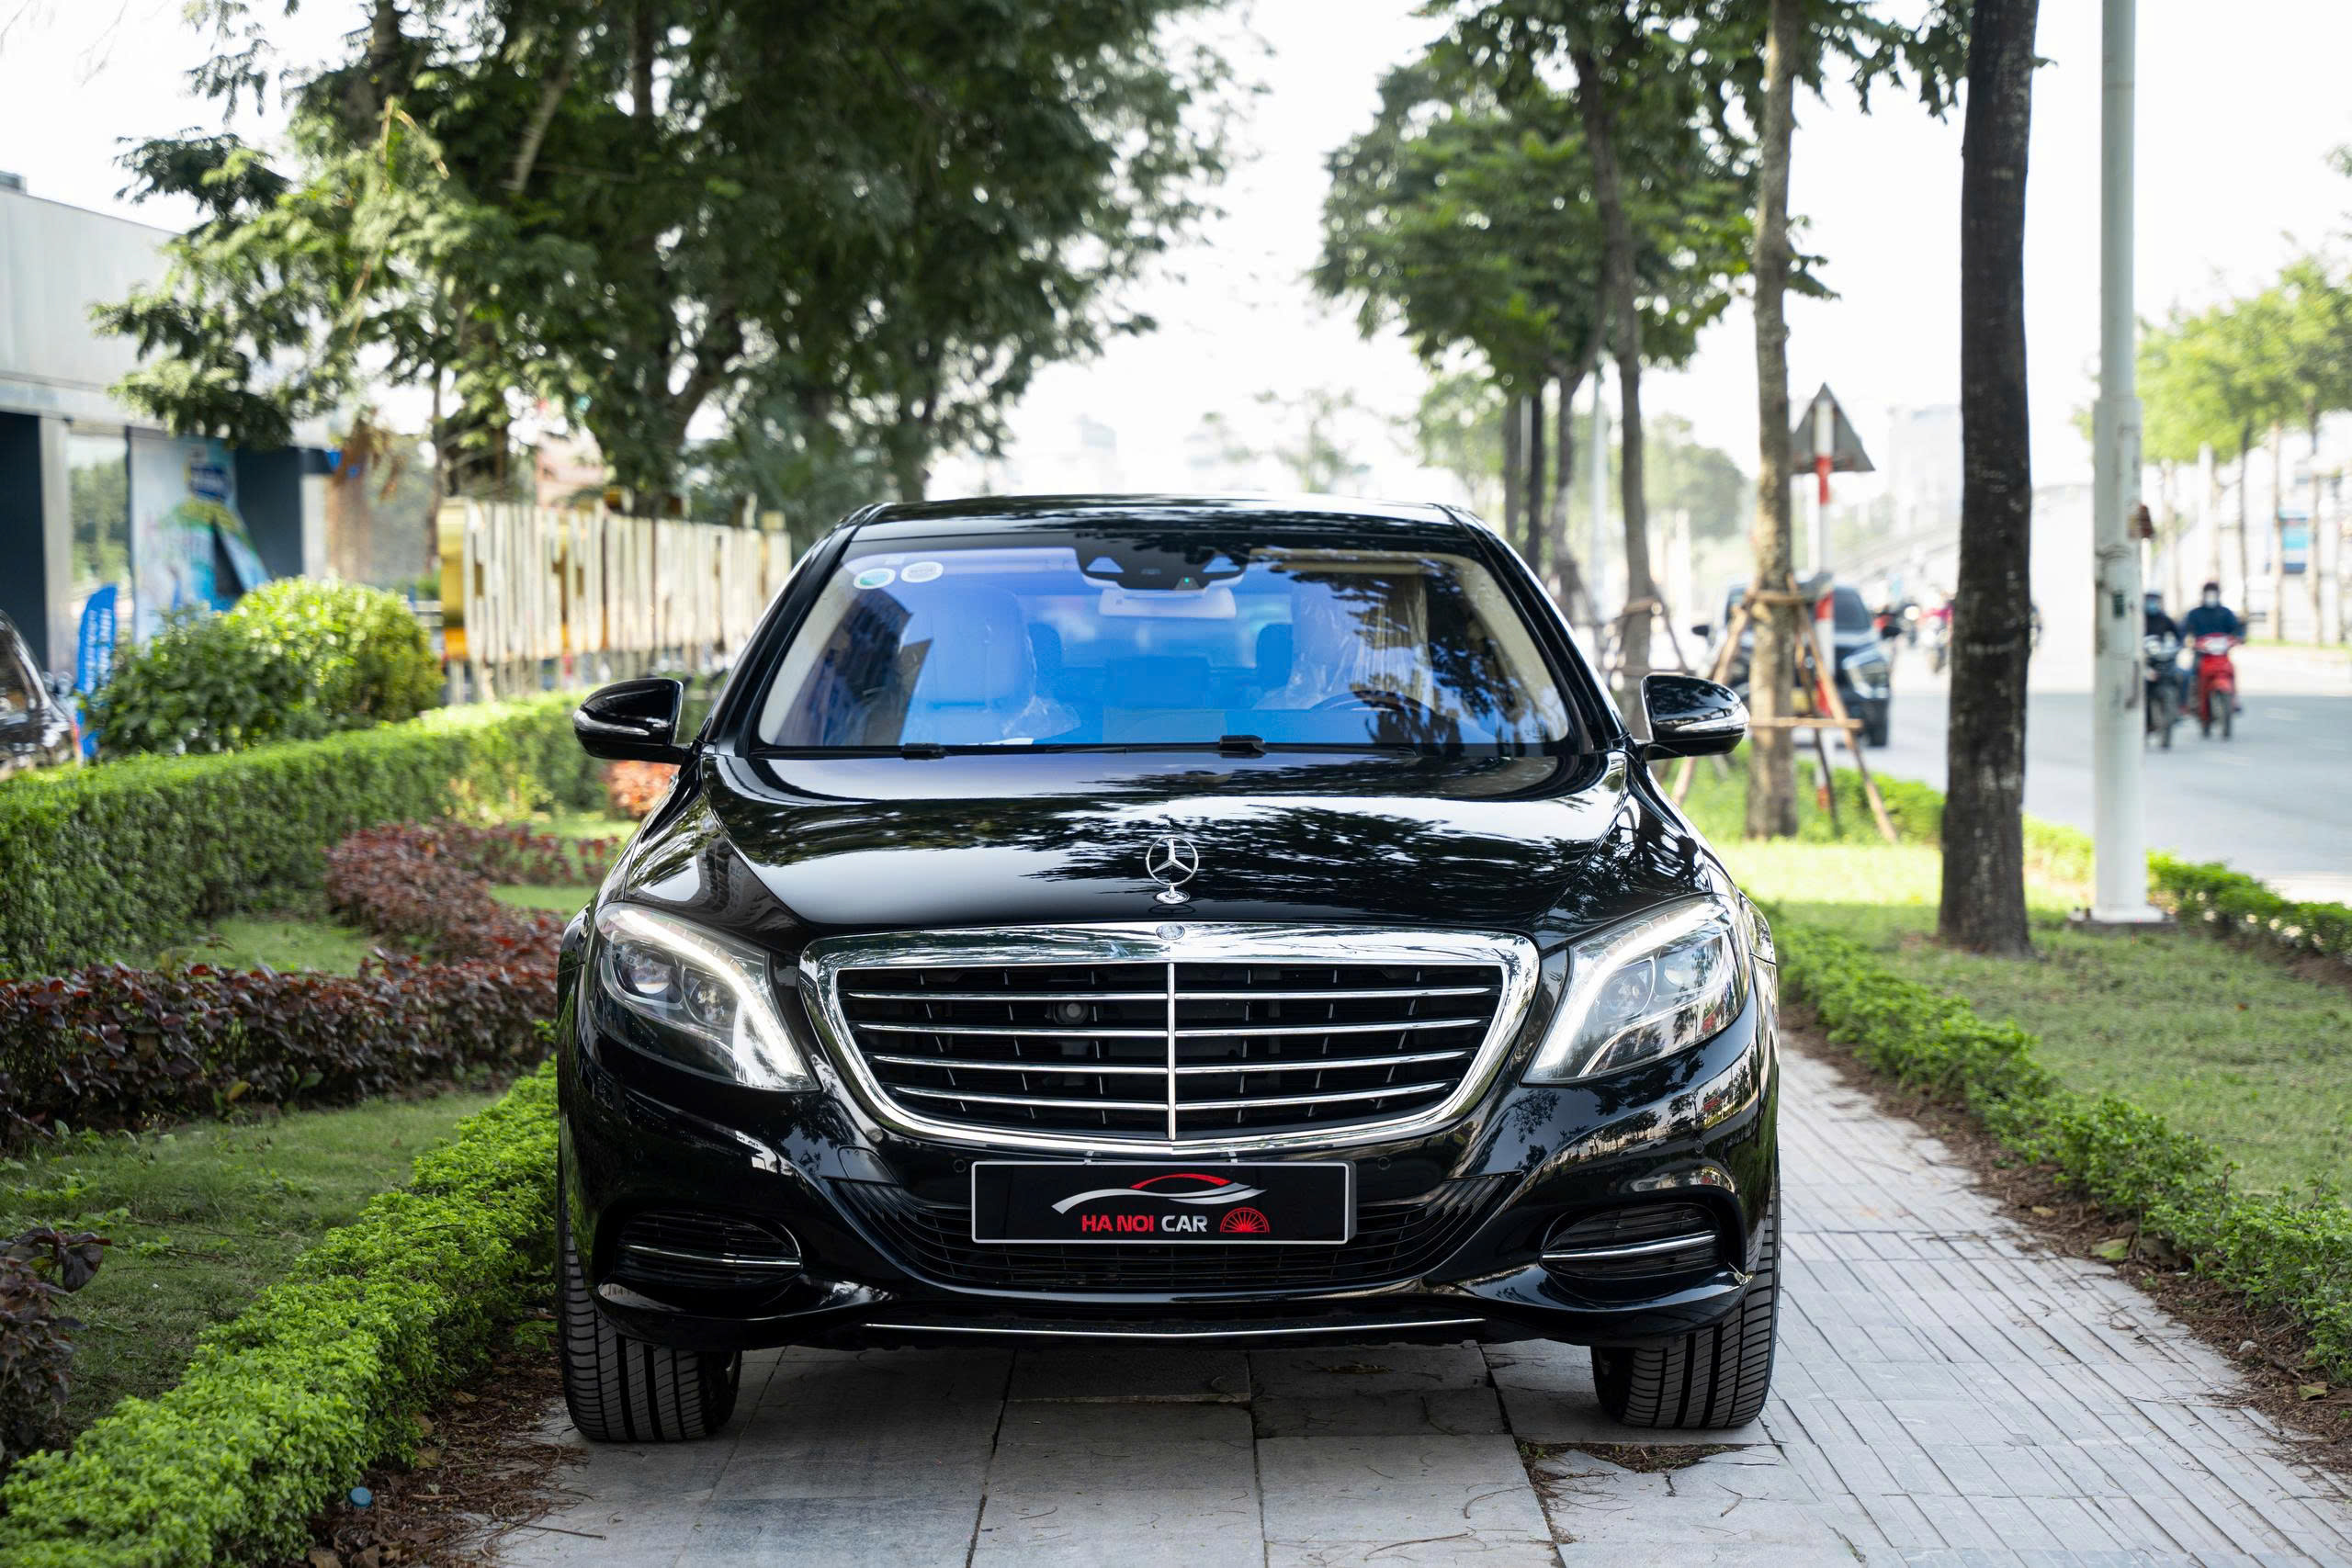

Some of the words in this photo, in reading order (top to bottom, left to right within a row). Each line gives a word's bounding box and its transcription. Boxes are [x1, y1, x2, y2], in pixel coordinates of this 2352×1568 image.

[1081, 1214, 1114, 1233] HA
[1116, 1214, 1155, 1233] NOI
[1161, 1214, 1208, 1233] CAR
